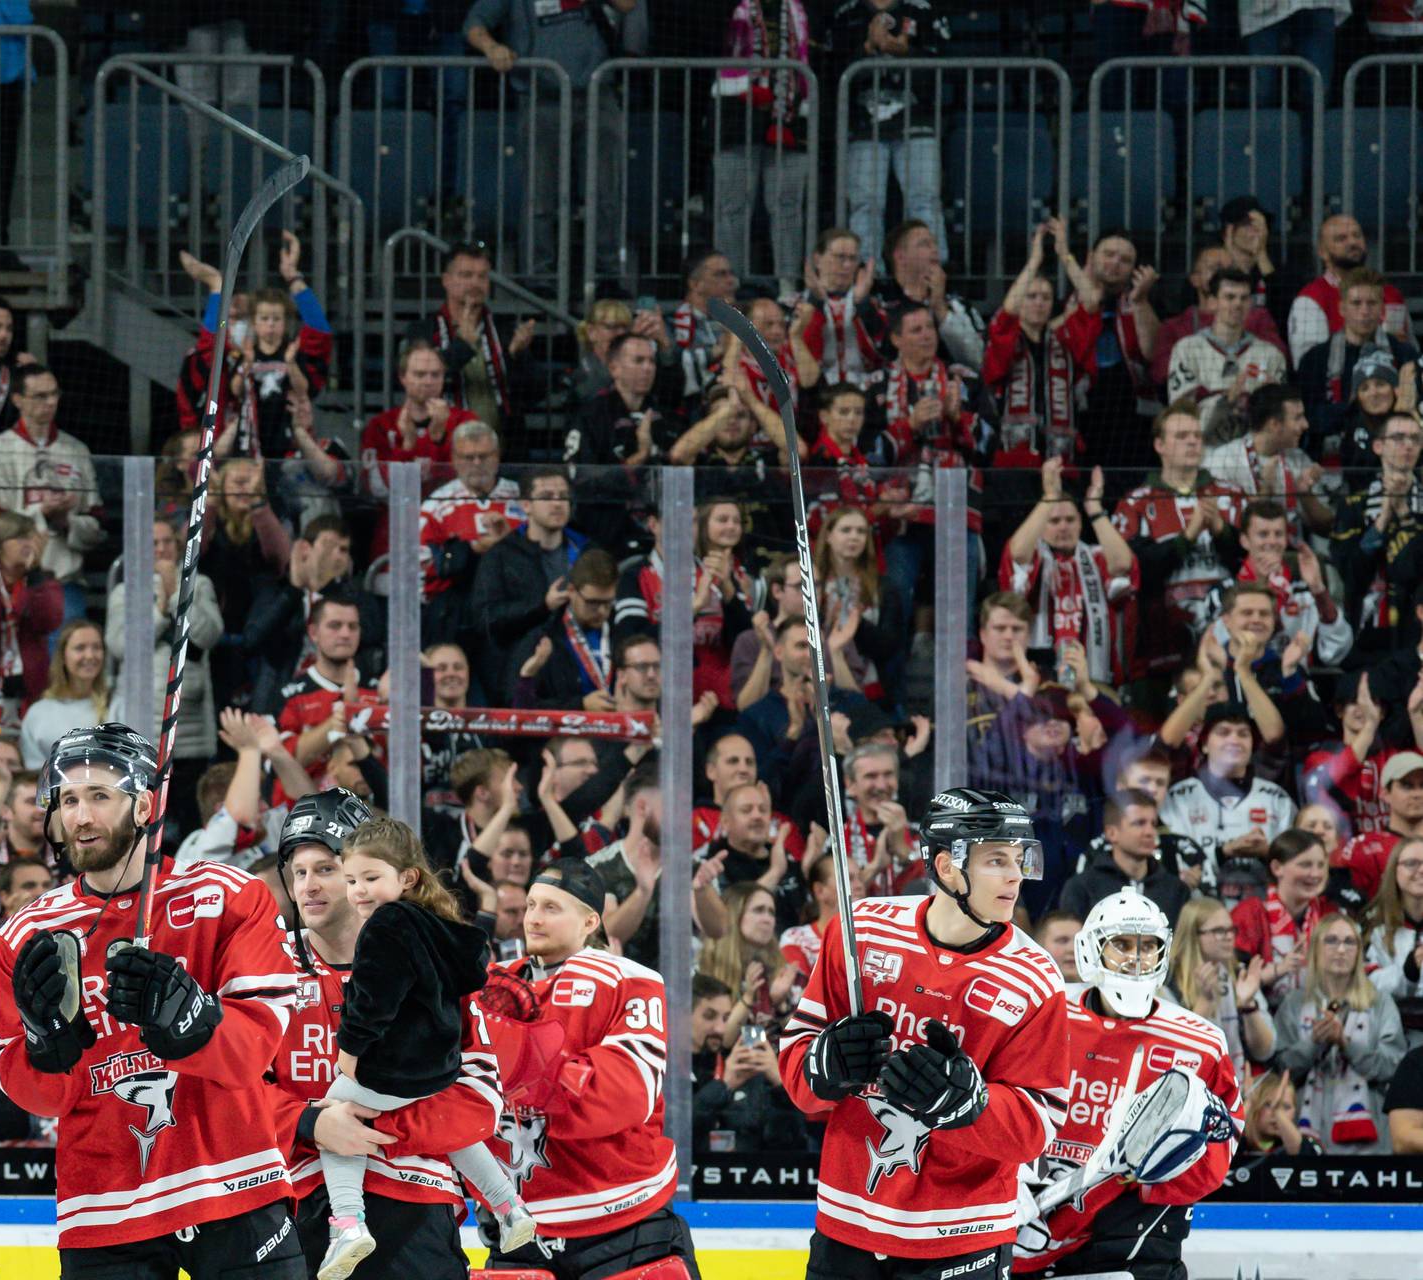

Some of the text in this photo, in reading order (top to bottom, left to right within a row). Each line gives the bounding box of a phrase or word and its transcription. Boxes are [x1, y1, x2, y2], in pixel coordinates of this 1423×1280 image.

[853, 901, 910, 919] HIT
[864, 947, 903, 978] 50
[1012, 947, 1062, 980] HIT
[625, 997, 664, 1032] 30
[93, 1052, 165, 1090] KÖLNE
[1120, 1093, 1149, 1134] VAUGHN
[613, 1191, 649, 1211] BAUER
[256, 1216, 292, 1262] BAUER
[949, 1223, 995, 1236] BAUER
[940, 1252, 997, 1280] BAUER
